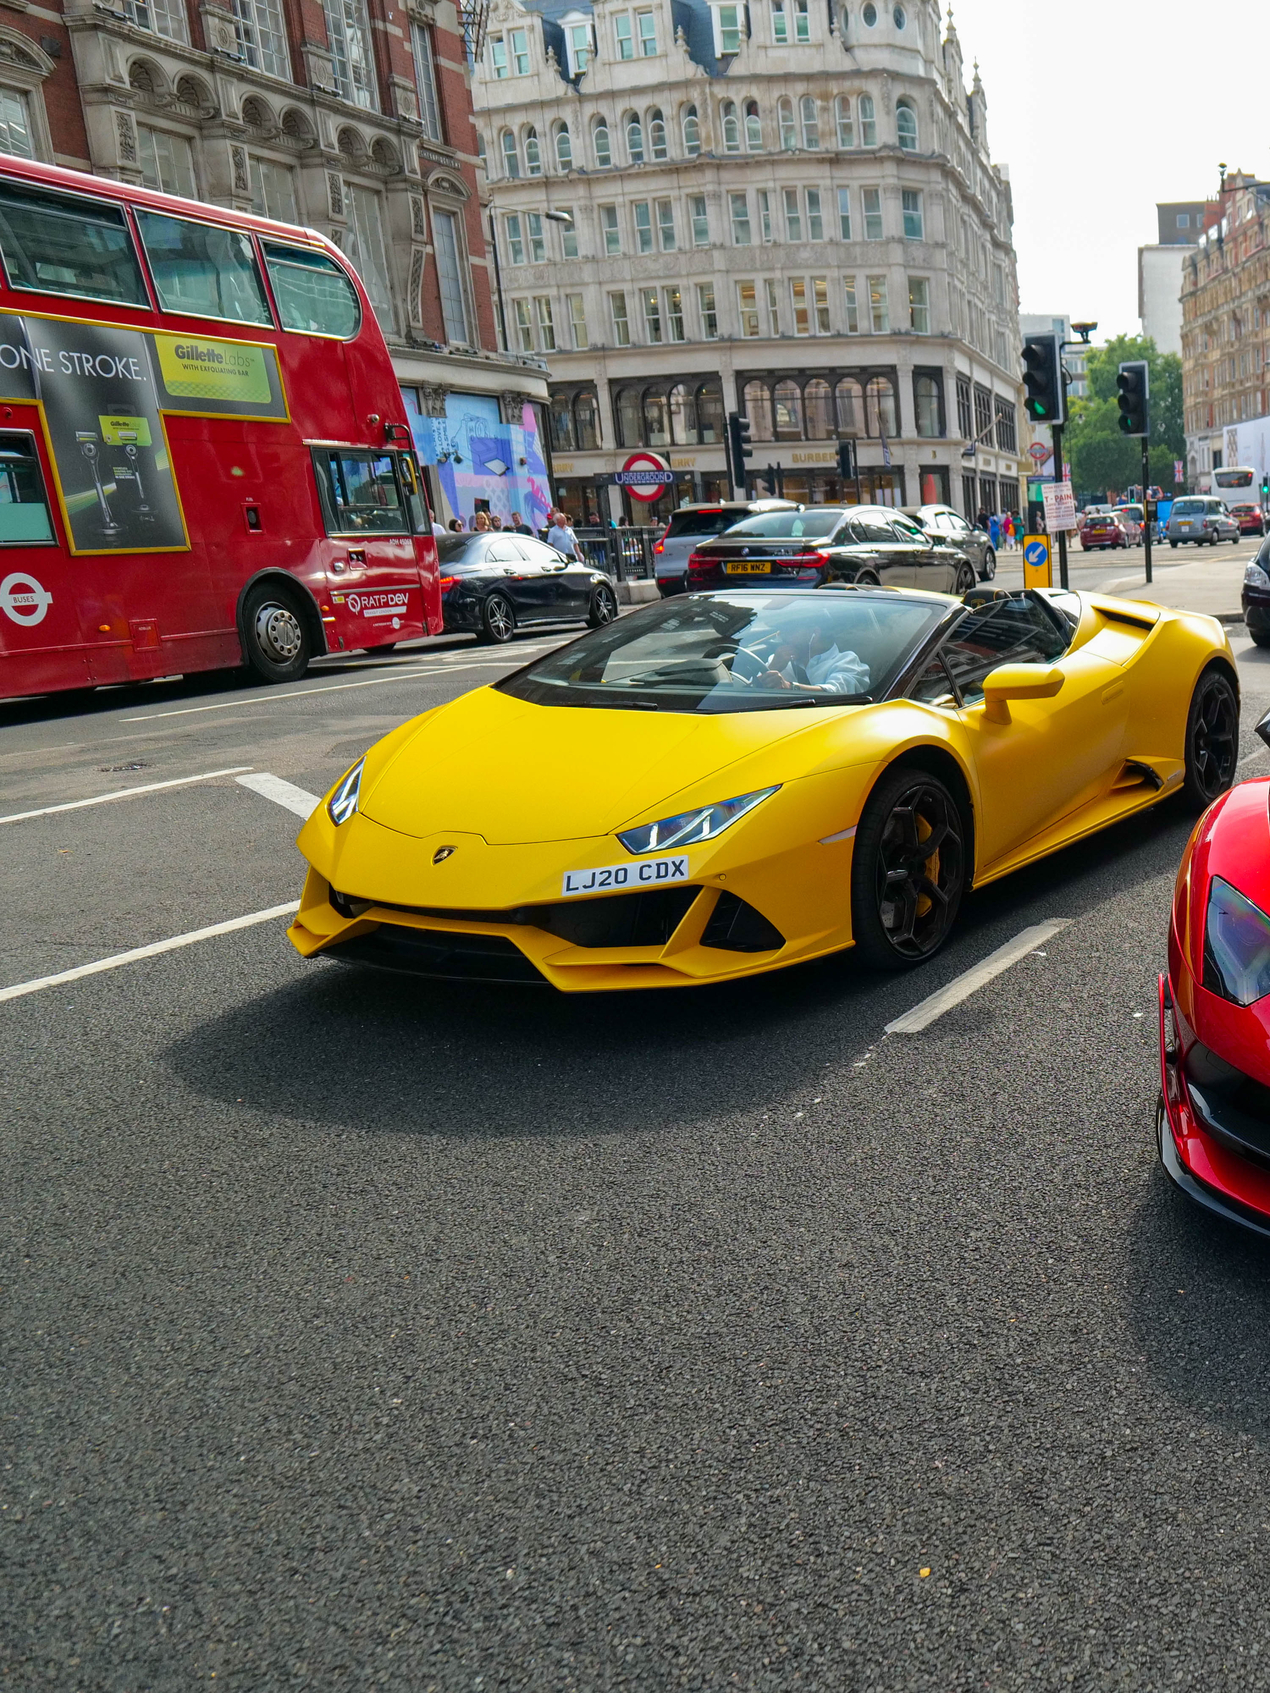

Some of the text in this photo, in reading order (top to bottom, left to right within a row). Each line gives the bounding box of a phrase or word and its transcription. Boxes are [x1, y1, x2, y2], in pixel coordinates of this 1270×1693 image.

[0, 344, 147, 381] ONE STROKE.
[181, 363, 250, 377] WITH EXFOLIATING BAR
[792, 453, 836, 463] BURBER
[615, 471, 673, 484] UNDERGROUND
[1054, 494, 1072, 502] PAIN
[13, 595, 35, 604] BUSES
[361, 594, 386, 607] RATP
[565, 859, 685, 892] LJ20 CDX
